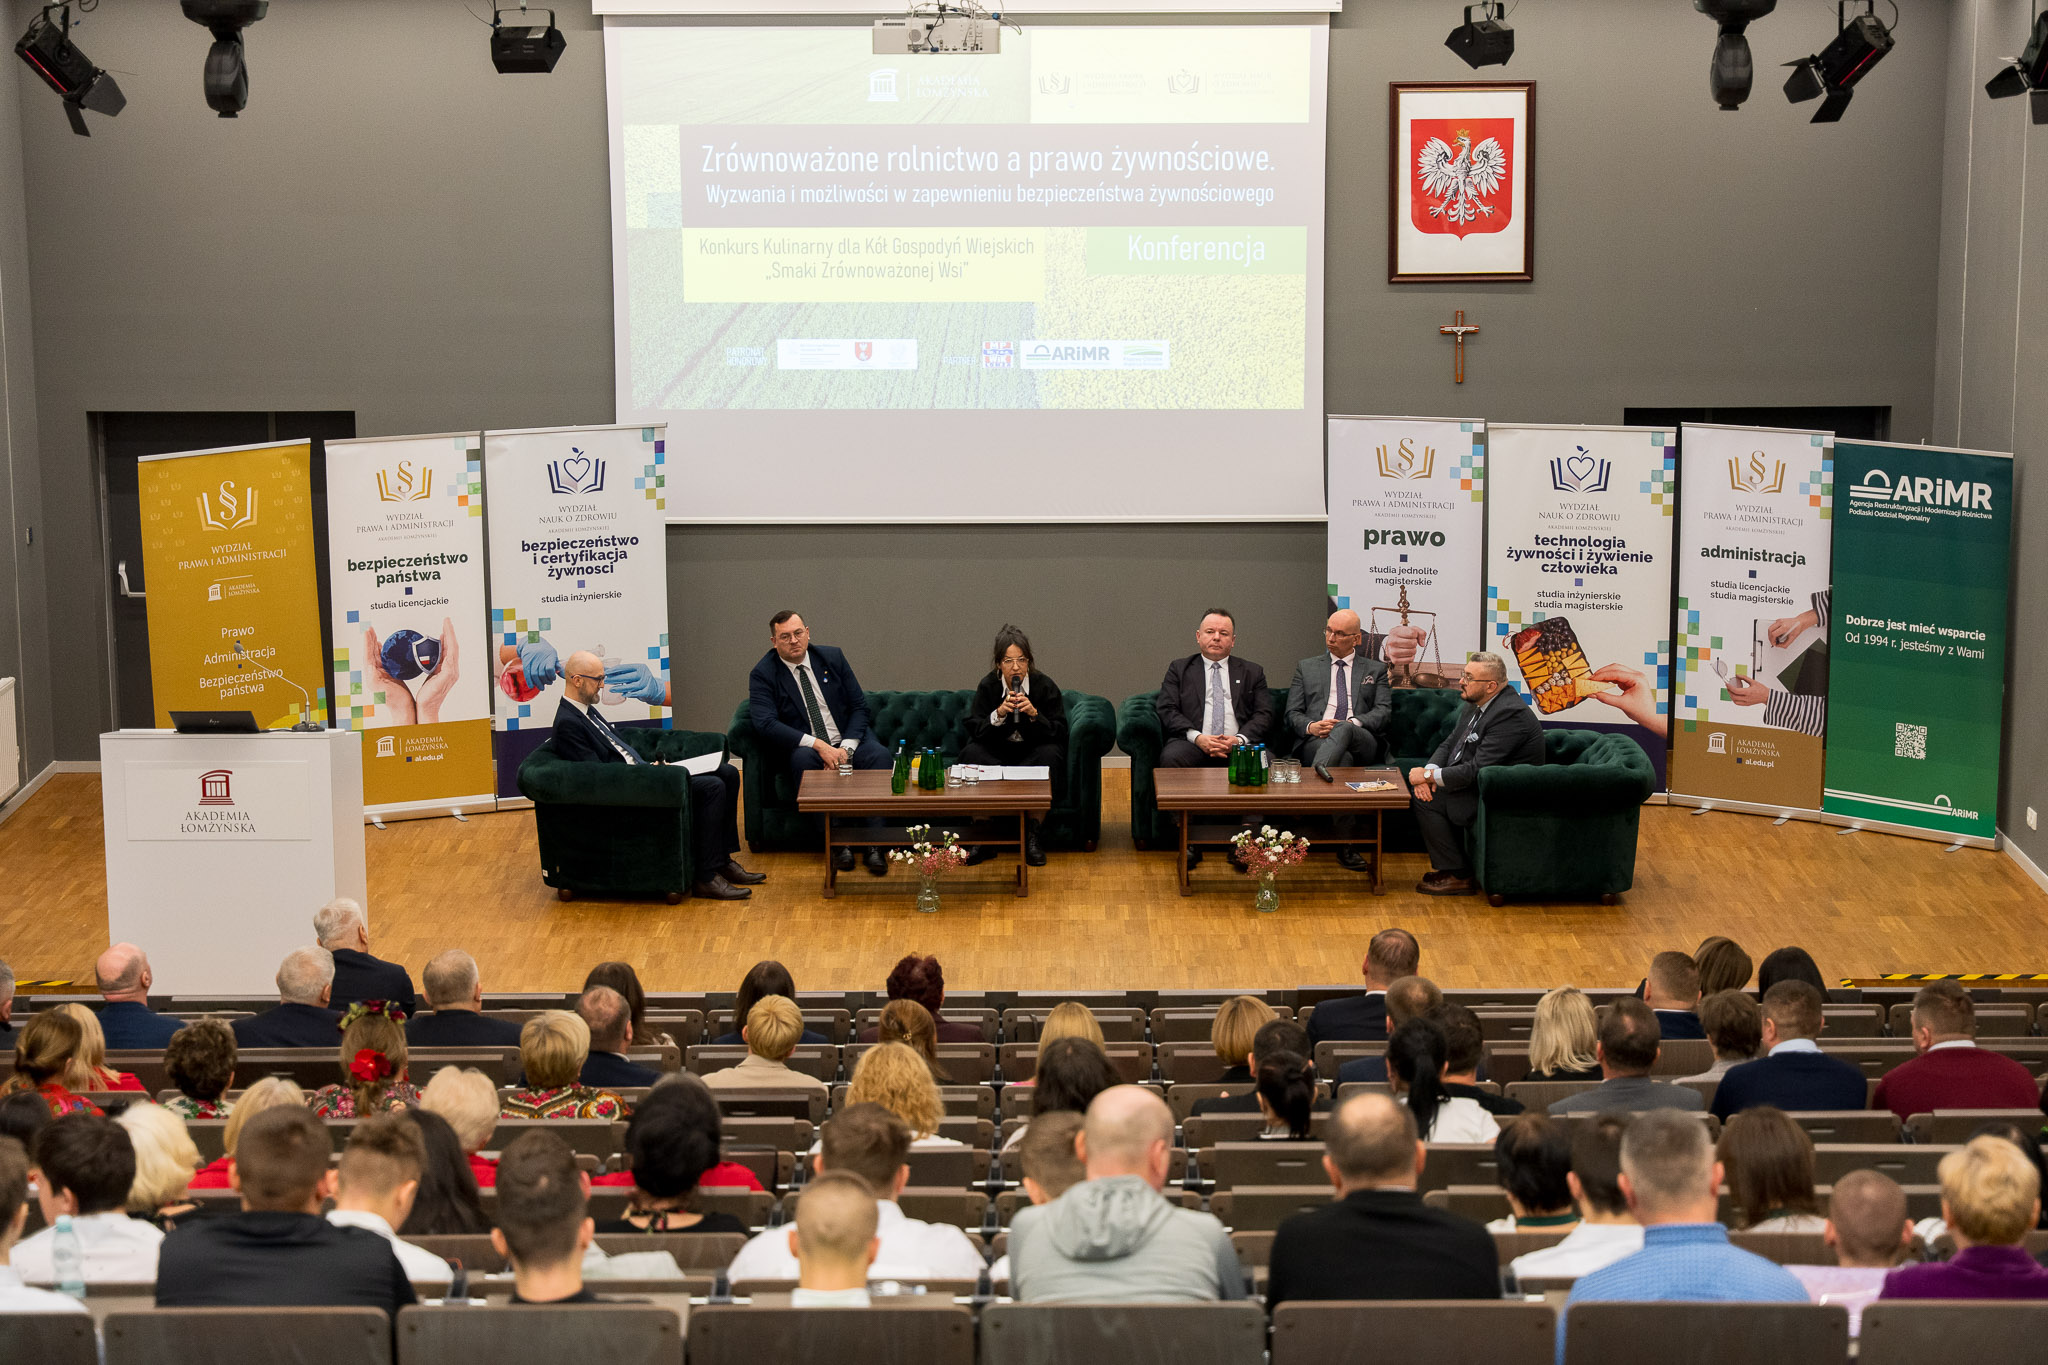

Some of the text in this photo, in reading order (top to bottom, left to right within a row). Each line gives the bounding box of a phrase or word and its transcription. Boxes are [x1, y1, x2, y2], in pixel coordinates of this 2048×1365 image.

[702, 140, 1276, 178] Zrównoważone rolnictwo a prawo żywnościowe.
[706, 181, 1274, 208] Wyzwania i możliwości w zapewnieniu bezpieczeństwa żywnościowego
[699, 236, 1034, 259] Konkurs Kulinarny dla Kół Gospodyń Wiejskich
[1128, 234, 1265, 267] Konferencja
[765, 261, 817, 280] „Smaki
[821, 260, 934, 282] Zrównoważonej
[1052, 347, 1110, 360] ARiMR
[1384, 490, 1423, 499] WYDZIAŁ
[1893, 475, 1992, 510] ARiMR
[558, 504, 597, 513] WYDZIAŁ
[1352, 500, 1381, 508] PRAWA
[1388, 501, 1455, 511] ADMINISTRACJI
[1560, 503, 1600, 511] WYDZIAŁ
[1736, 504, 1773, 514] WYDZIAŁ
[1850, 500, 1873, 508] Agencja
[1874, 502, 1921, 513] Restrukturyzacji
[1925, 507, 1961, 517] Modernizacji
[1962, 510, 1992, 519] Rolnictwa
[386, 512, 424, 522] WYDZIAŁ
[538, 516, 564, 524] NAUK
[575, 512, 618, 522] ZDROWIU
[1538, 512, 1620, 521] NAUK O ZDROWIU
[1703, 512, 1731, 521] PRAWA
[1739, 515, 1804, 527] ADMINISTRACJI
[1849, 508, 1873, 516] Podlaski
[1898, 513, 1930, 523] Regionalny
[356, 525, 383, 533] PRAWA
[390, 520, 454, 531] ADMINISTRACJI
[521, 534, 639, 553] bezpieczeństwo
[1364, 529, 1446, 550] prawo
[1534, 535, 1626, 550] technologia
[211, 542, 252, 554] WYDZIAŁ
[178, 558, 208, 570] PRAWA
[216, 548, 287, 565] ADMINISTRACJI
[347, 552, 469, 573] bezpieczeństwo
[533, 548, 628, 566] i certyfikacja
[1506, 547, 1653, 564] żywności i żywienie
[1701, 545, 1806, 567] administracja
[1369, 566, 1438, 576] studia jednolite
[1541, 563, 1618, 575] człowieka
[376, 569, 441, 588] państwa
[1375, 576, 1432, 587] magisterskie
[1711, 580, 1790, 594] studia licencjackie
[541, 590, 622, 604] studia inżynierskie
[1567, 591, 1621, 601] inżynierskie
[1710, 591, 1794, 606] studia magisterskie
[370, 597, 449, 610] studia licencjackie
[1534, 601, 1623, 611] studia magisterskie
[221, 625, 255, 638] Prawo
[1846, 614, 1986, 641] Dobrze jest mieć wsparcie
[1845, 632, 1985, 660] Od 1994 r. jesteśmy z Wami
[204, 646, 276, 665] Administracja
[200, 669, 283, 688] Bezpieczeństwo
[220, 683, 264, 700] państwa
[406, 736, 444, 745] AKADEMIA
[1737, 739, 1775, 749] AKADEMIA
[414, 753, 444, 762] al.edu.pl
[1745, 759, 1774, 768] al.edu.pl
[185, 811, 250, 821] AKADEMIA
[1951, 808, 1979, 820] ARiMR
[180, 821, 256, 833] ŁOMŻYŃSKA
